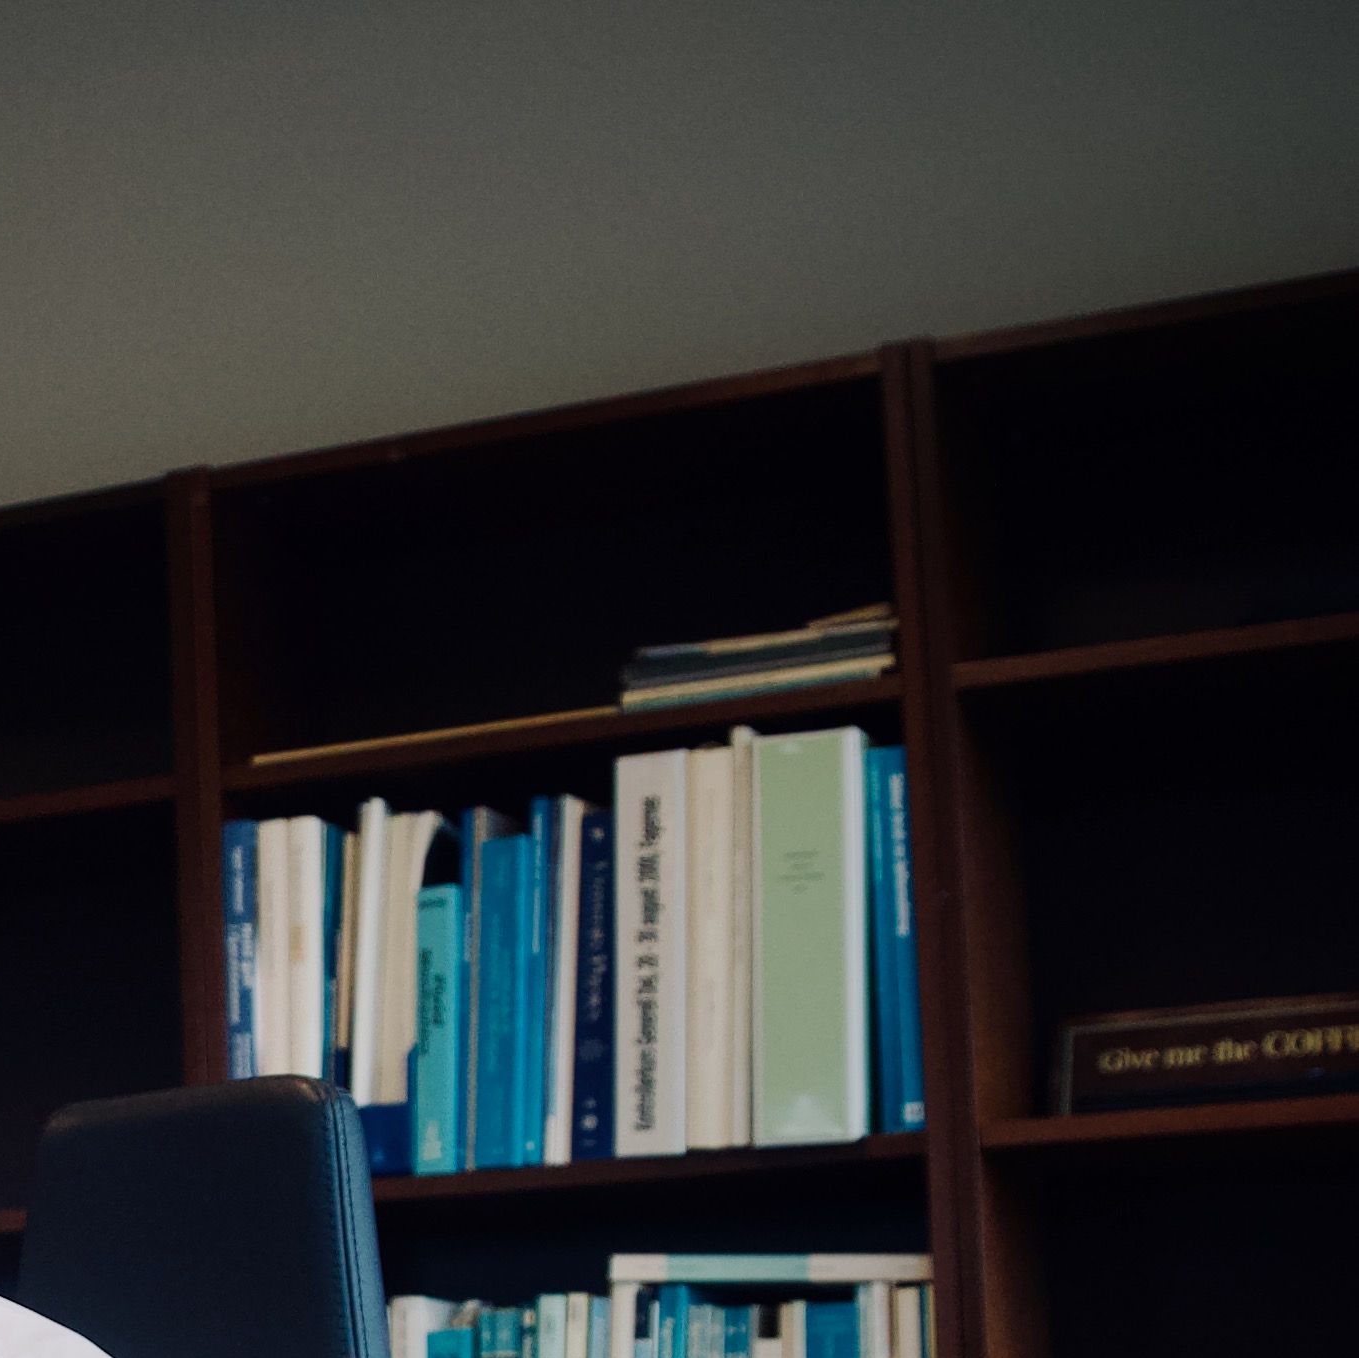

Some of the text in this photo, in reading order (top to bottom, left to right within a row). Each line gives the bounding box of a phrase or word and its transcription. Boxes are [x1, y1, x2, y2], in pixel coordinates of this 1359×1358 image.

[1099, 1047, 1160, 1073] Give
[1164, 1045, 1207, 1068] me
[1212, 1037, 1258, 1064] the
